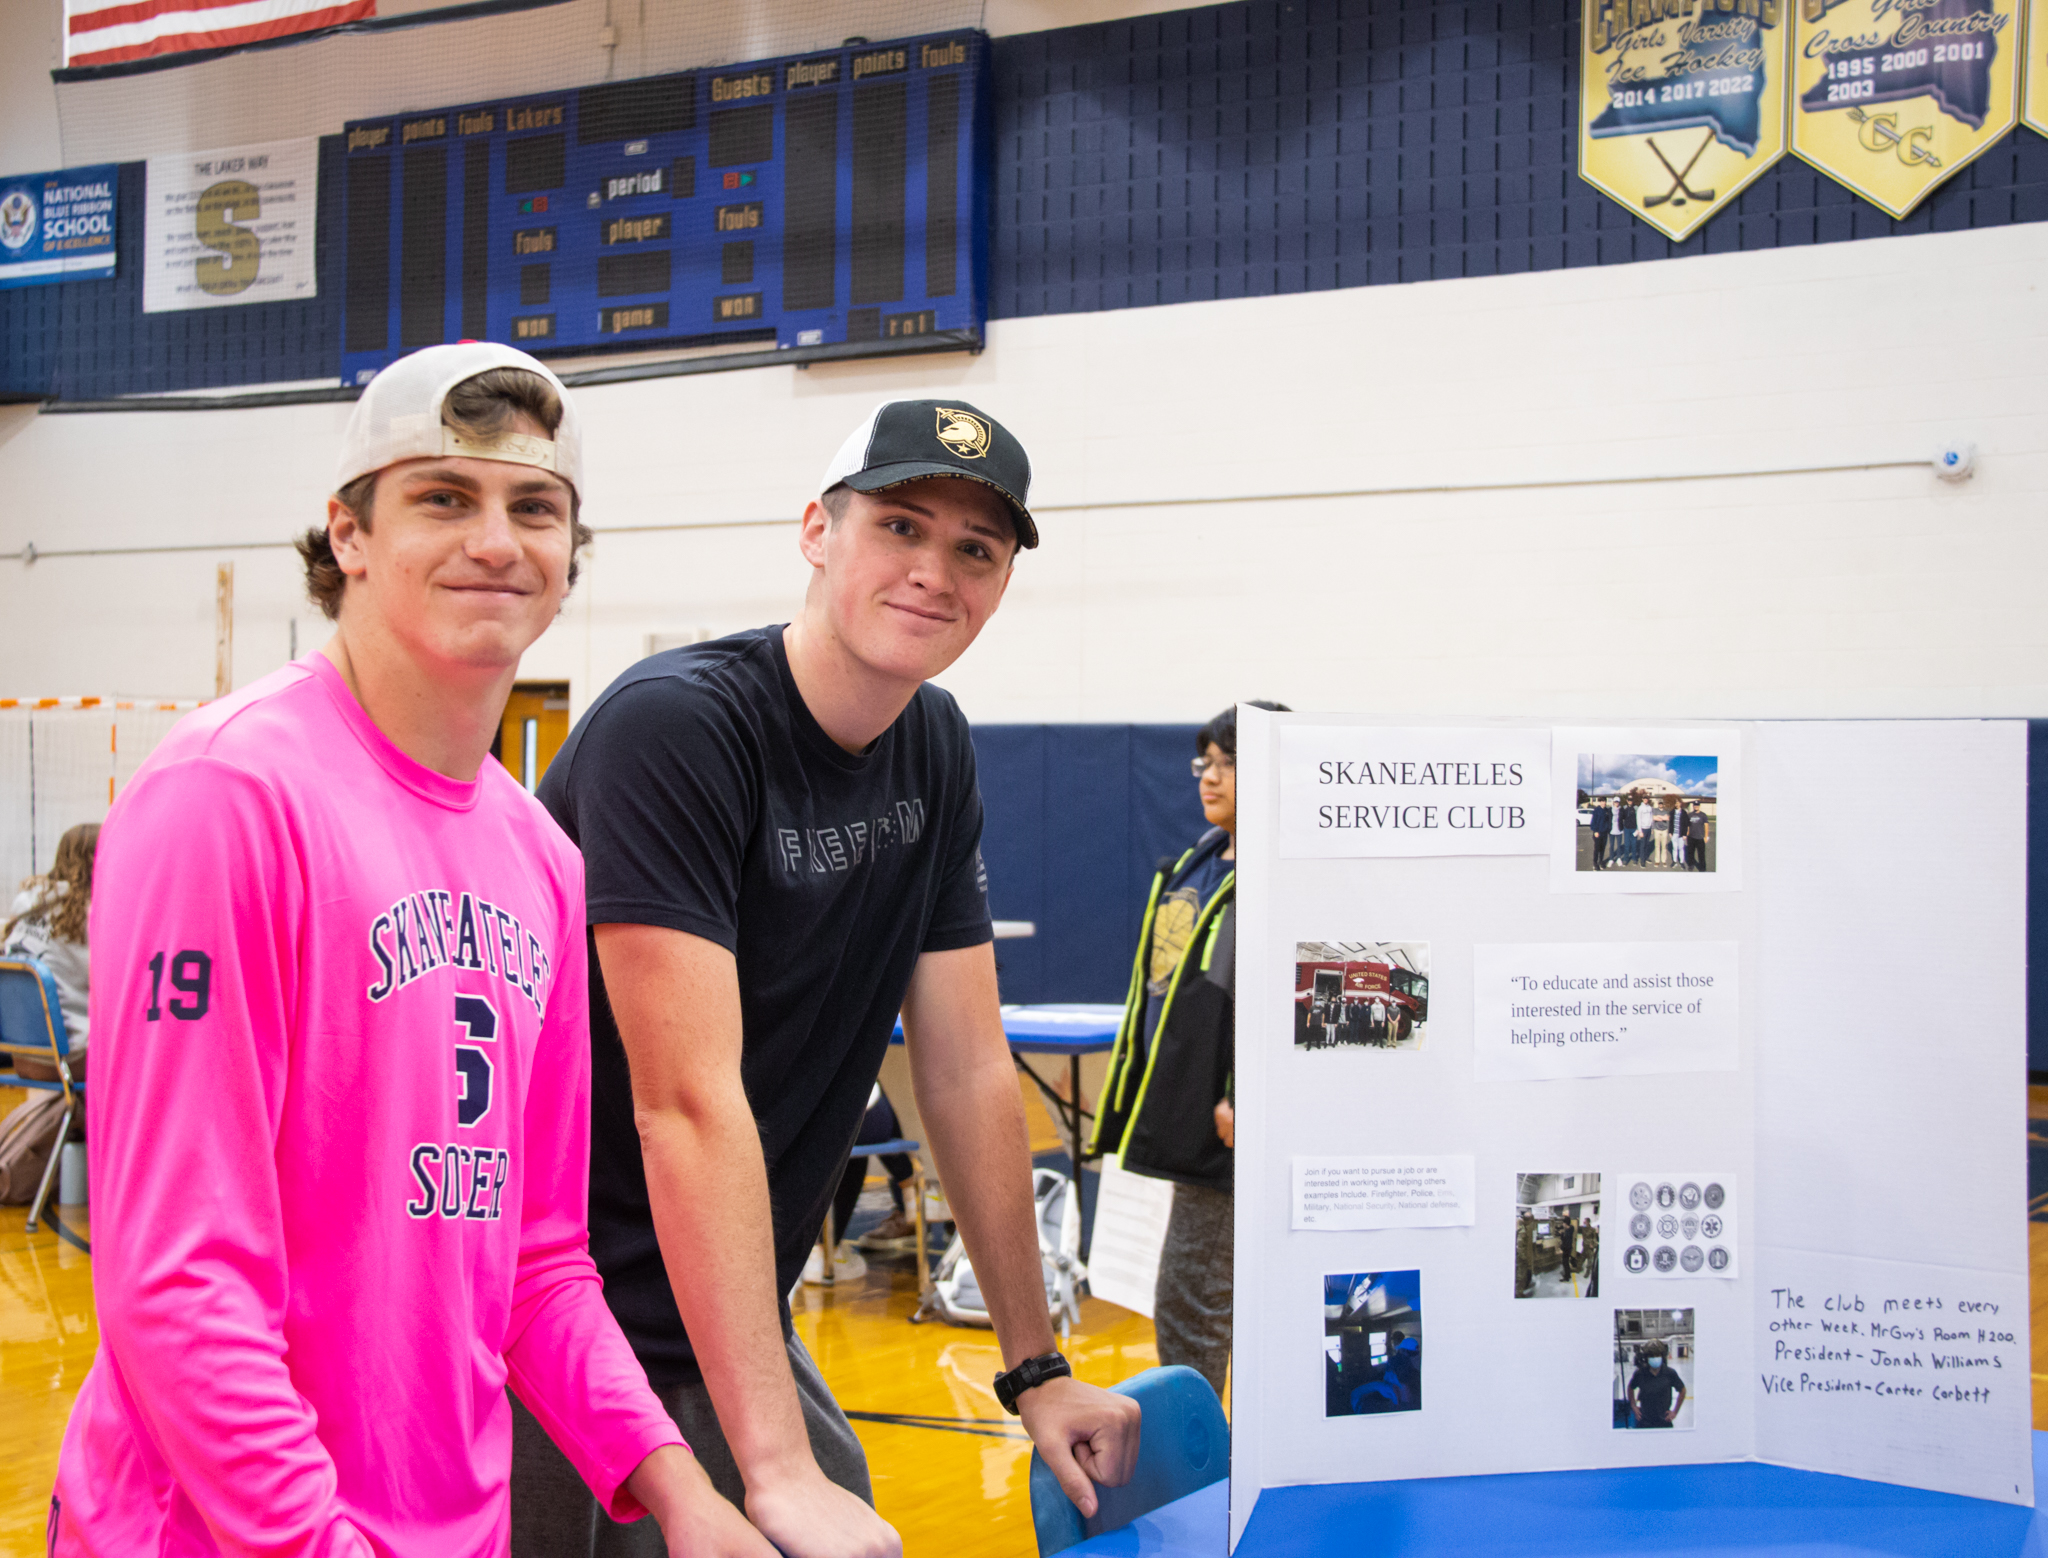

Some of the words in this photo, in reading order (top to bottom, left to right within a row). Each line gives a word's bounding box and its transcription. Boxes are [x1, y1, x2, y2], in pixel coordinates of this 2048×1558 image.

[1615, 27, 1666, 60] Girls
[1677, 17, 1756, 45] Varsity
[1803, 29, 1881, 59] Cross
[1891, 10, 2010, 48] Country
[854, 50, 906, 80] points
[922, 41, 966, 68] fouls
[1605, 60, 1646, 86] Ice
[1660, 44, 1766, 78] Hockey
[1828, 57, 1876, 80] 1995
[1881, 49, 1929, 72] 2000
[1933, 42, 1984, 63] 2001
[712, 75, 771, 101] Guests
[787, 61, 836, 90] player
[1612, 88, 1656, 109] 2014
[1660, 80, 1706, 102] 2017
[1709, 75, 1754, 97] 2022
[1828, 80, 1875, 102] 2003
[403, 118, 446, 146] points
[459, 112, 494, 134] fouls
[507, 106, 562, 132] Lakers
[348, 126, 390, 153] player
[195, 162, 212, 175] THE
[214, 158, 246, 175] LAKER
[44, 182, 112, 205] NATIONAL
[608, 168, 662, 200] period
[44, 214, 112, 240] SCHOOL
[719, 205, 758, 231] fouls
[516, 230, 553, 254] fouls
[610, 218, 662, 245] player
[721, 296, 754, 317] won
[518, 318, 548, 338] won
[612, 308, 654, 334] game
[1318, 760, 1524, 786] SKANEATELES
[1318, 804, 1438, 830] SERVICE
[1447, 804, 1526, 830] CLUB
[146, 950, 212, 1022] 19
[1542, 975, 1598, 990] educate
[1603, 974, 1628, 990] and
[1632, 974, 1672, 989] assist
[1676, 972, 1714, 988] those
[1511, 1002, 1582, 1018] interested
[1586, 1002, 1601, 1016] in
[1605, 1000, 1628, 1016] the
[1632, 1000, 1682, 1016] service
[1686, 998, 1702, 1014] of
[1511, 1029, 1565, 1048] helping
[1570, 1028, 1627, 1044] others.”
[1304, 1168, 1320, 1176] Join
[1322, 1168, 1326, 1176] if
[1328, 1168, 1341, 1177] you
[1342, 1168, 1360, 1176] want
[1370, 1168, 1396, 1176] pursue
[1403, 1167, 1415, 1176] job
[1350, 1178, 1378, 1188] working
[1380, 1178, 1394, 1186] with
[1396, 1178, 1422, 1187] helping
[1304, 1191, 1338, 1200] examples
[1334, 1202, 1364, 1210] National
[1398, 1201, 1428, 1209] National
[1771, 1288, 1805, 1310] The
[1824, 1294, 1865, 1312] club
[1884, 1297, 1942, 1314] meets
[1958, 1300, 1999, 1315] every
[1770, 1318, 1812, 1332] other
[1934, 1327, 1970, 1342] Room
[1870, 1348, 1923, 1368] Jonah
[1932, 1352, 2002, 1370] Williams
[1762, 1374, 1794, 1394] Vice
[1932, 1385, 1990, 1404] Corbett
